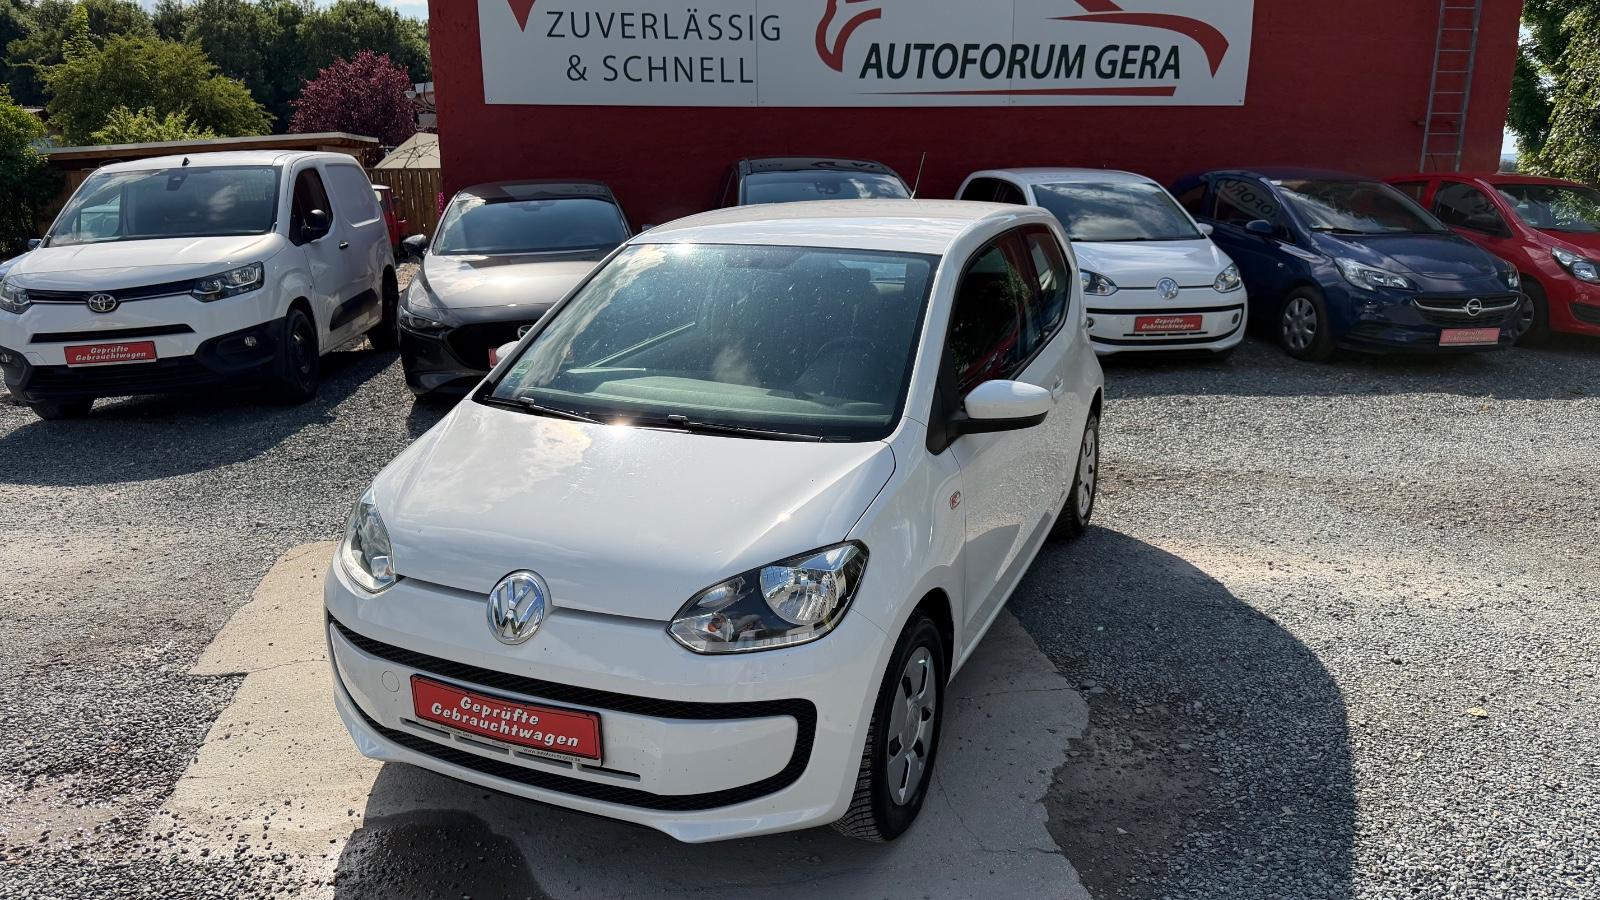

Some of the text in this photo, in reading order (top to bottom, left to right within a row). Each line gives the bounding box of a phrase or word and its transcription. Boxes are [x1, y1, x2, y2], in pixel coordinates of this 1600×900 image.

[546, 8, 782, 42] ZUVERLÄSSIG
[566, 54, 754, 84] & SCHNELL
[859, 42, 1181, 80] AUTOFORUM GERA
[75, 352, 146, 361] Gebrauchtwagen
[90, 346, 129, 354] Geprüfte
[431, 702, 579, 747] Gebrauchtwagen
[460, 696, 539, 725] Geprüfte
